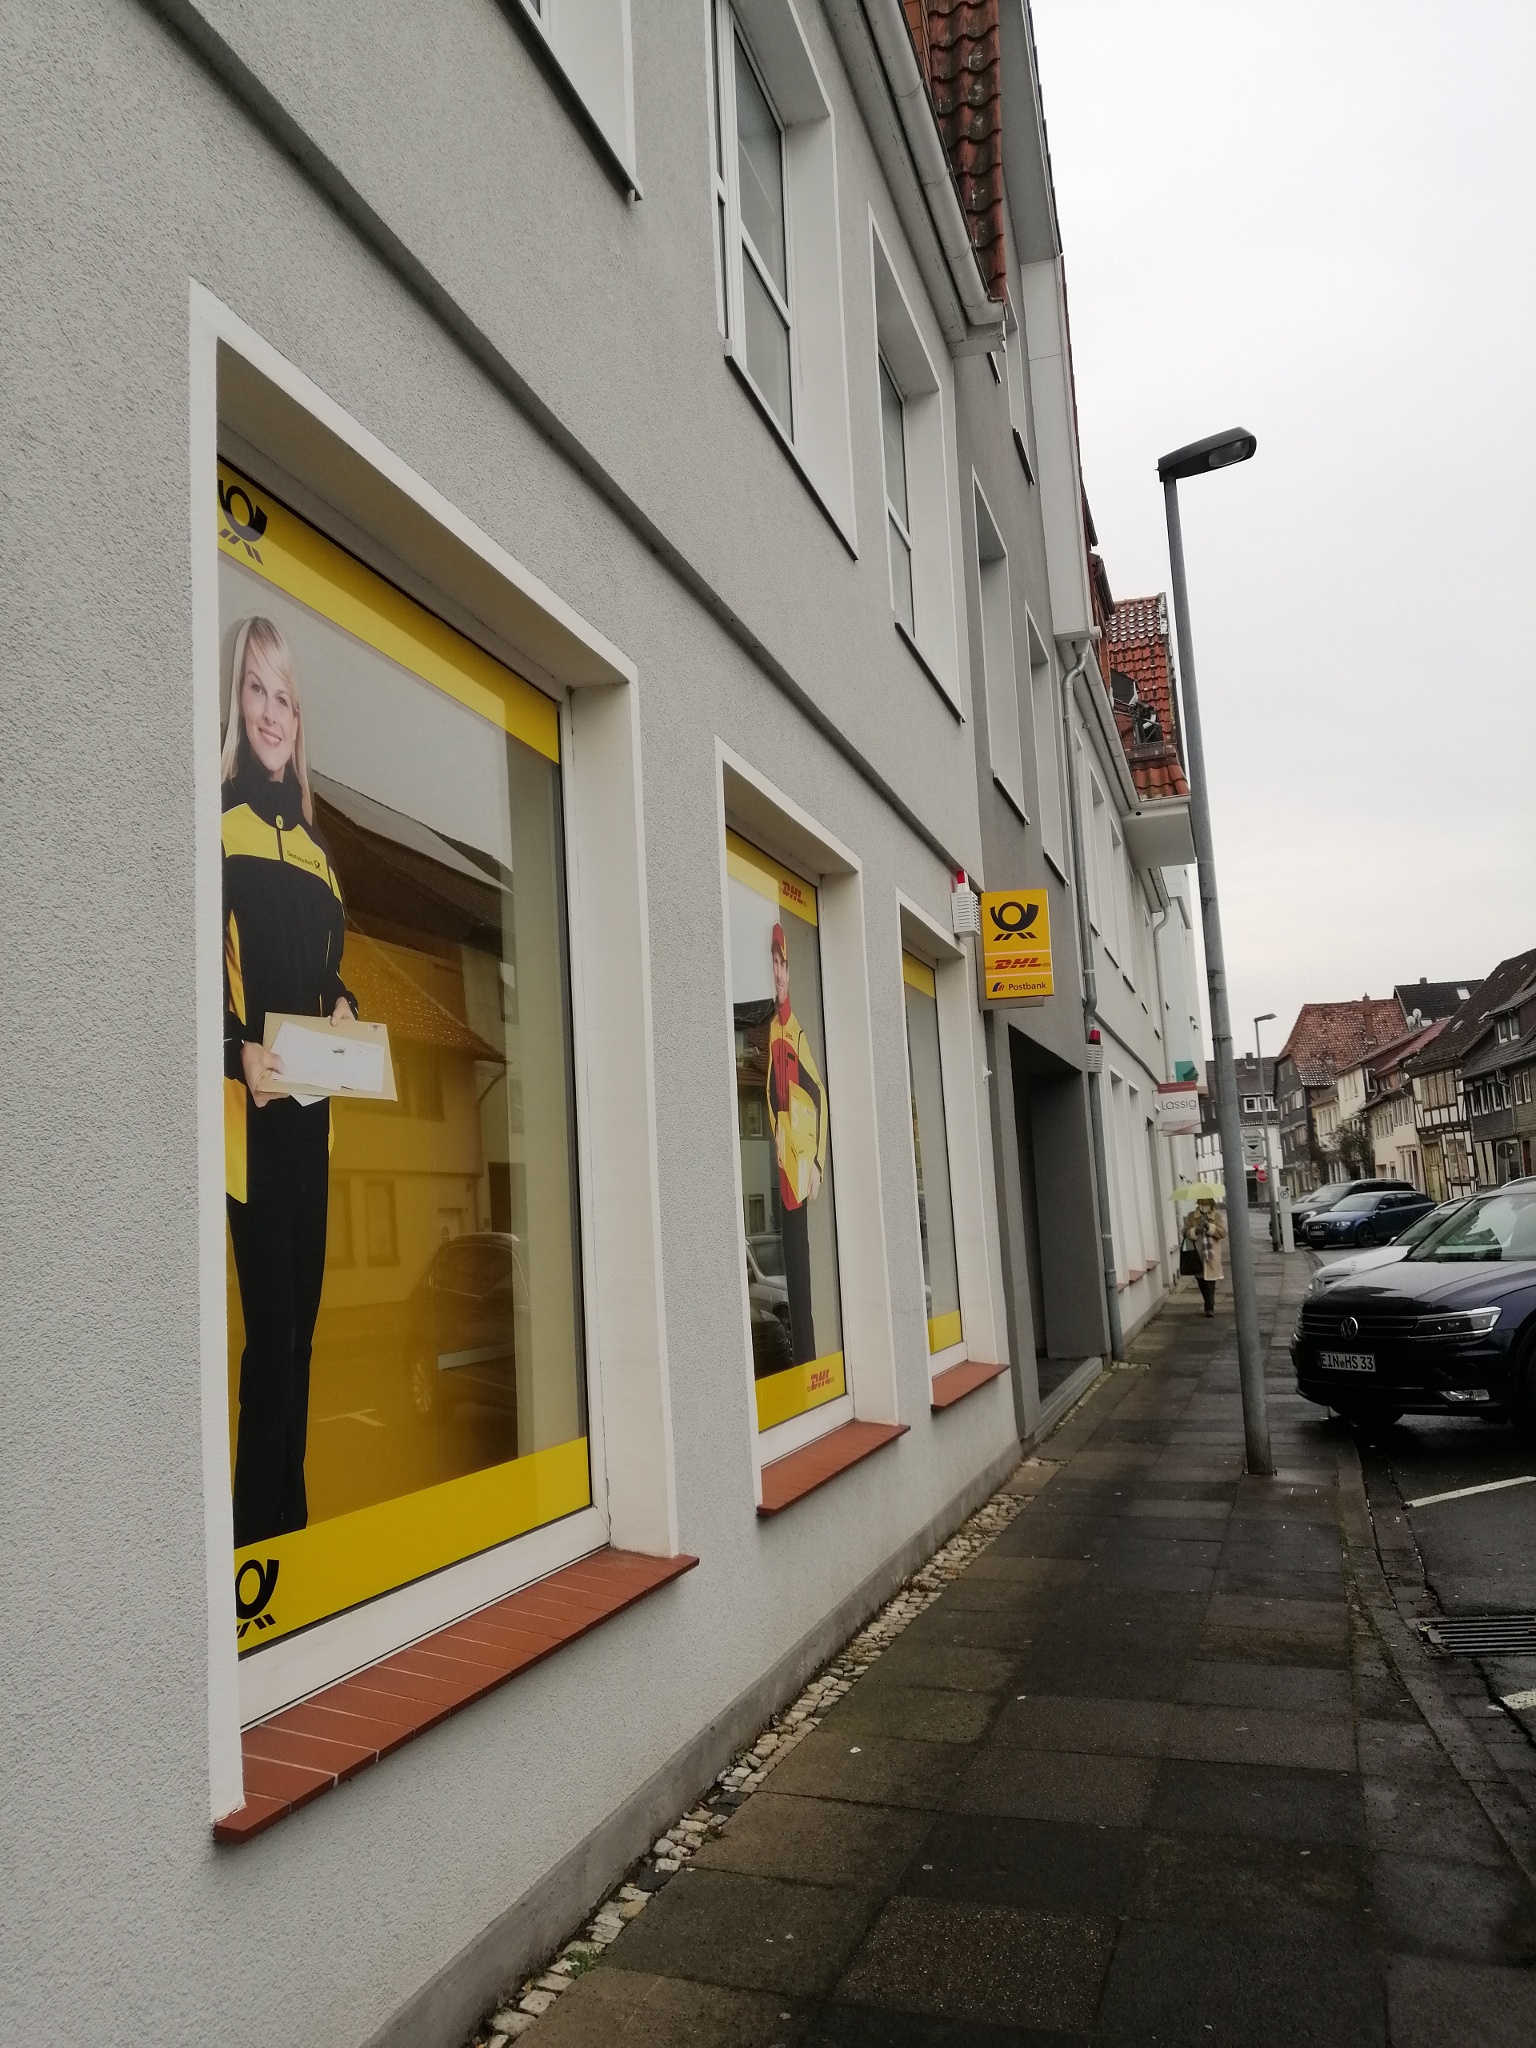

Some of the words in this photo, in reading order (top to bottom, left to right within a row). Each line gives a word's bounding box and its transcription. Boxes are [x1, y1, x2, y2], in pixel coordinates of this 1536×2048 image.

[782, 880, 803, 904] DHL
[994, 957, 1042, 970] DHL
[1008, 981, 1047, 991] Postbank
[1321, 1354, 1340, 1368] EIN
[1344, 1355, 1359, 1370] HS
[1360, 1356, 1374, 1371] 33
[810, 1369, 830, 1391] DHL
